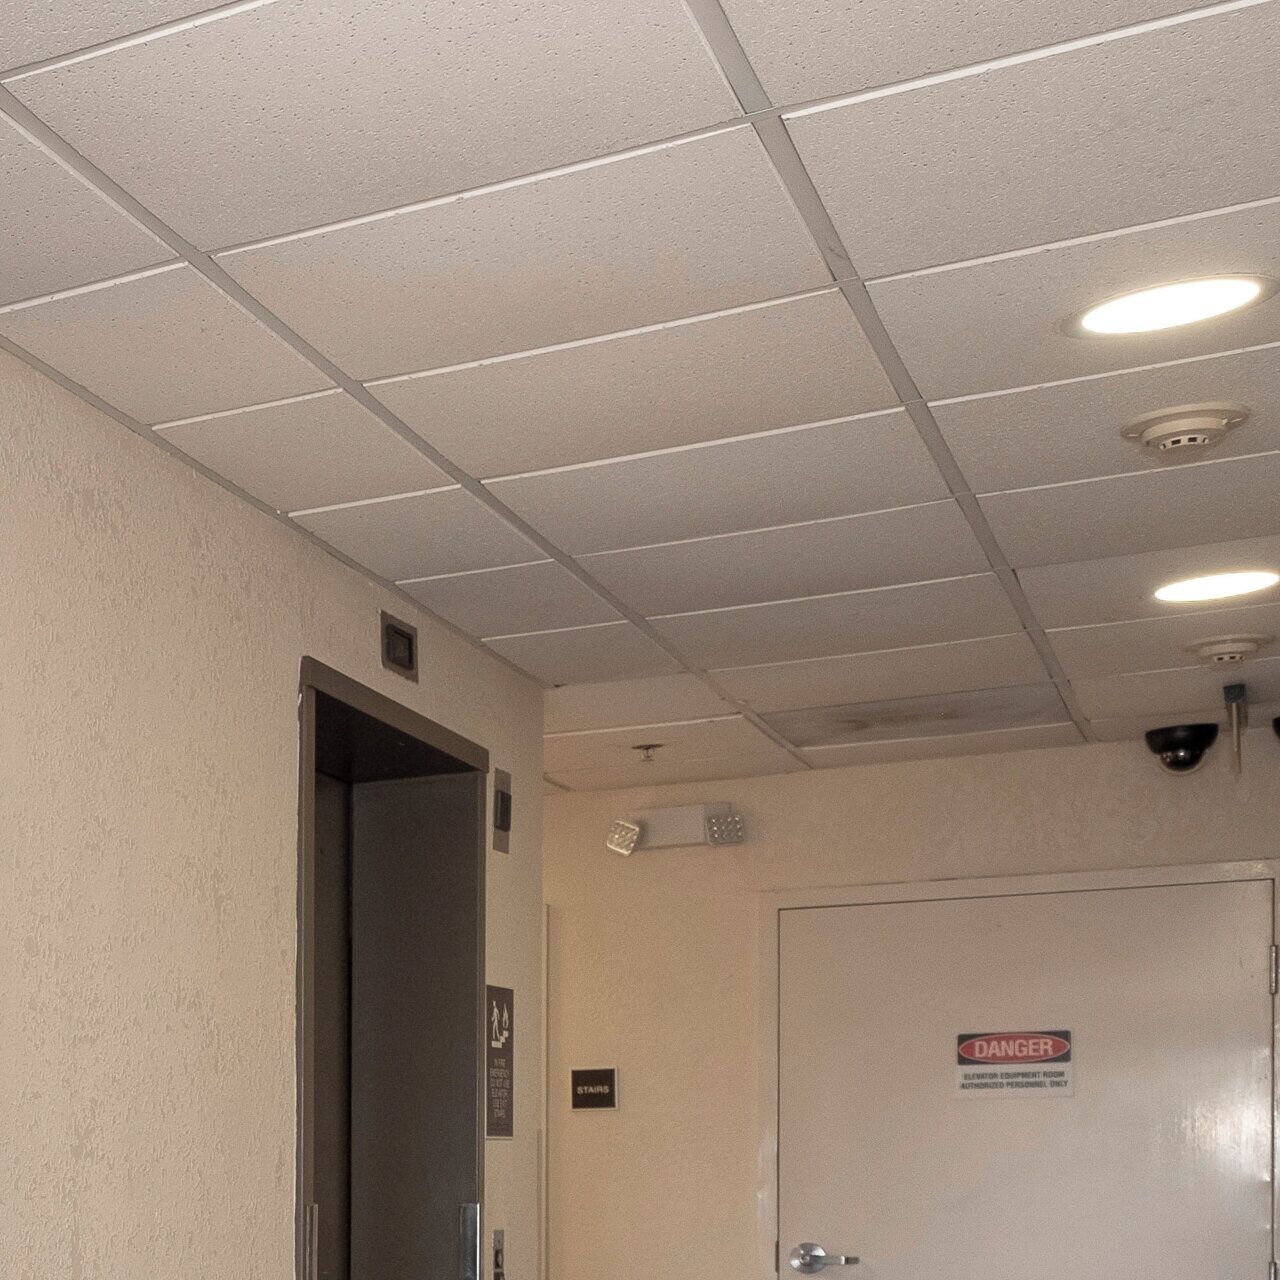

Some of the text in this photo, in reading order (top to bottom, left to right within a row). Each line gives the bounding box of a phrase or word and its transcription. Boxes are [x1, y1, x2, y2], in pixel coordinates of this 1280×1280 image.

[974, 1039, 1053, 1058] DANGER
[963, 1070, 1065, 1081] ELEVATOR EQUIPMENT ROOM
[576, 1085, 610, 1095] STAIRS
[960, 1080, 1069, 1090] AUTHORIZED PERSONNEL ONLY
